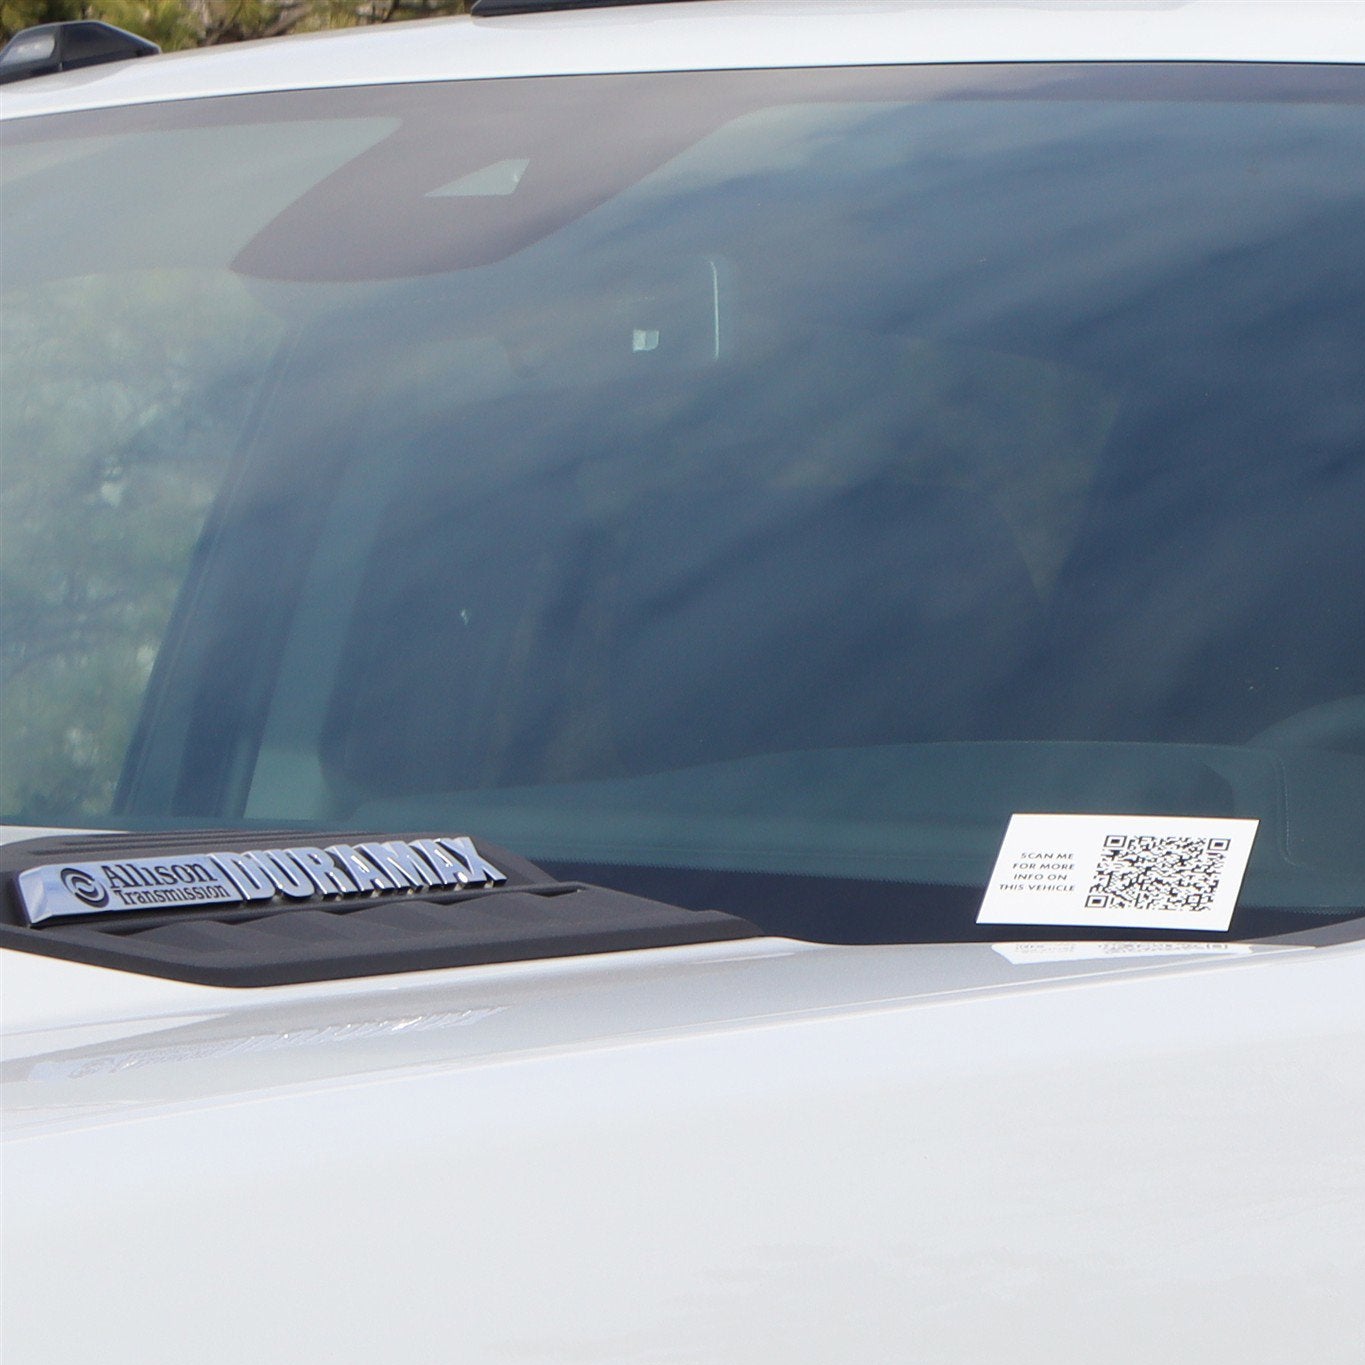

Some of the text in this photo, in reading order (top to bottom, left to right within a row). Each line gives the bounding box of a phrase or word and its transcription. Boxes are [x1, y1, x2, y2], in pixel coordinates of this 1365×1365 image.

[103, 862, 218, 888] Allison
[209, 836, 507, 902] DURAMAX
[113, 884, 230, 905] Transmission
